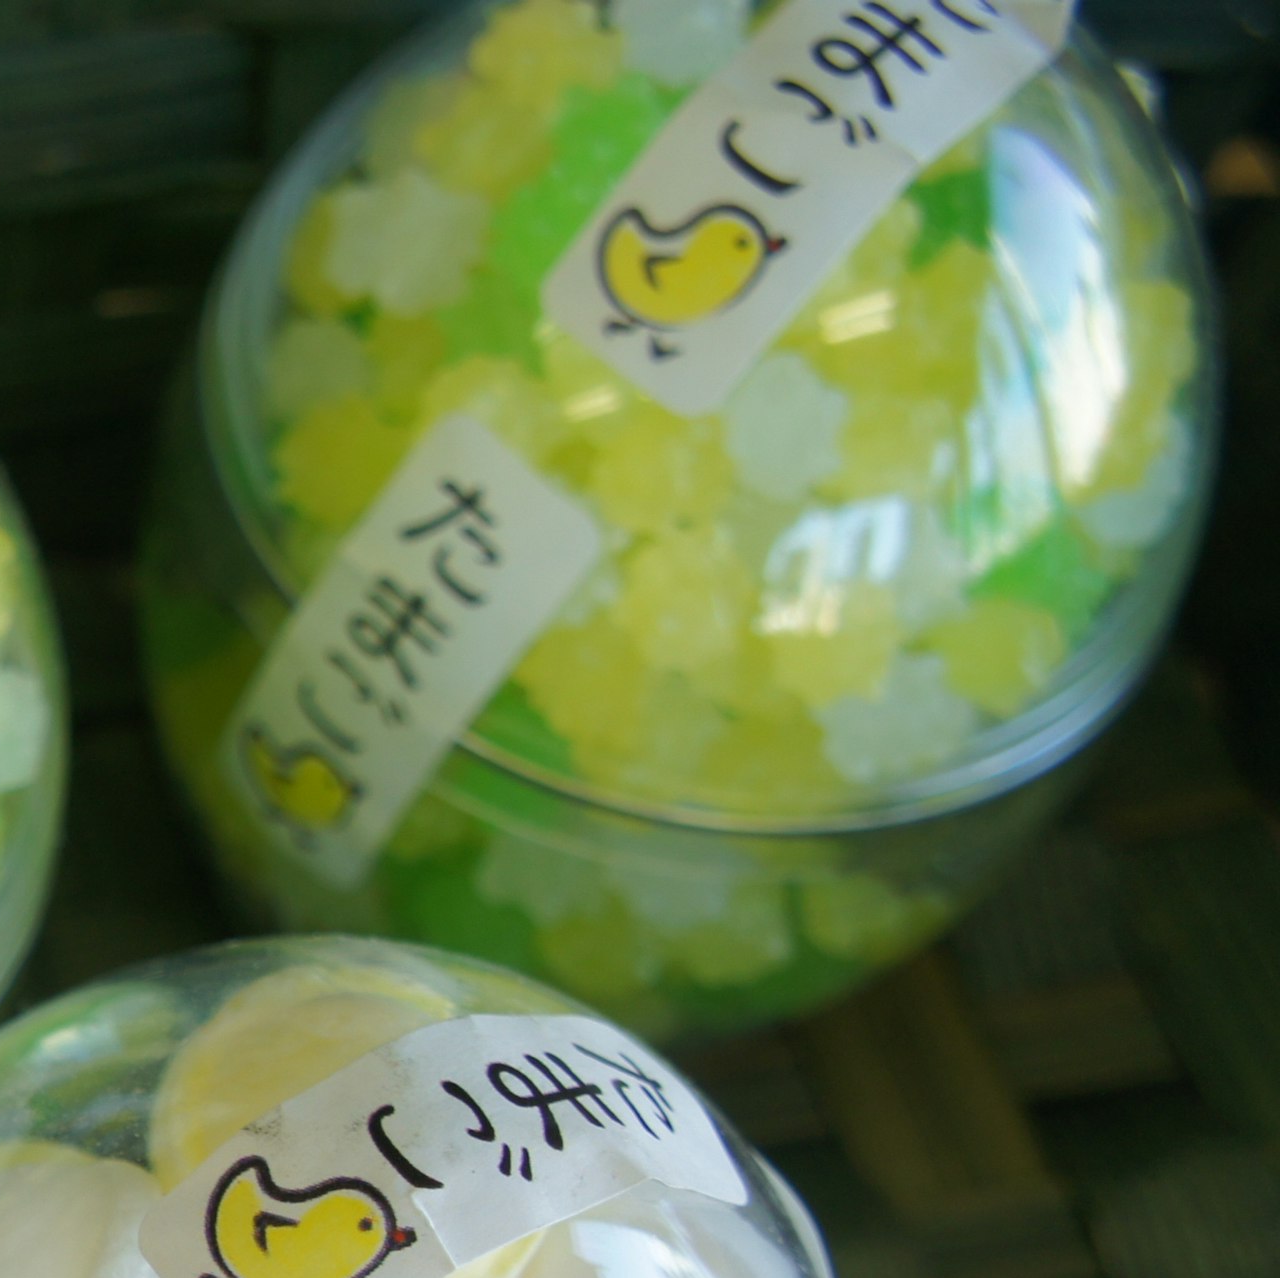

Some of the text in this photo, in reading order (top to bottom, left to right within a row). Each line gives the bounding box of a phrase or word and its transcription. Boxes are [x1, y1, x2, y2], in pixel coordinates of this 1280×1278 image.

[296, 477, 501, 755] たまご
[367, 1042, 676, 1190] たまご
